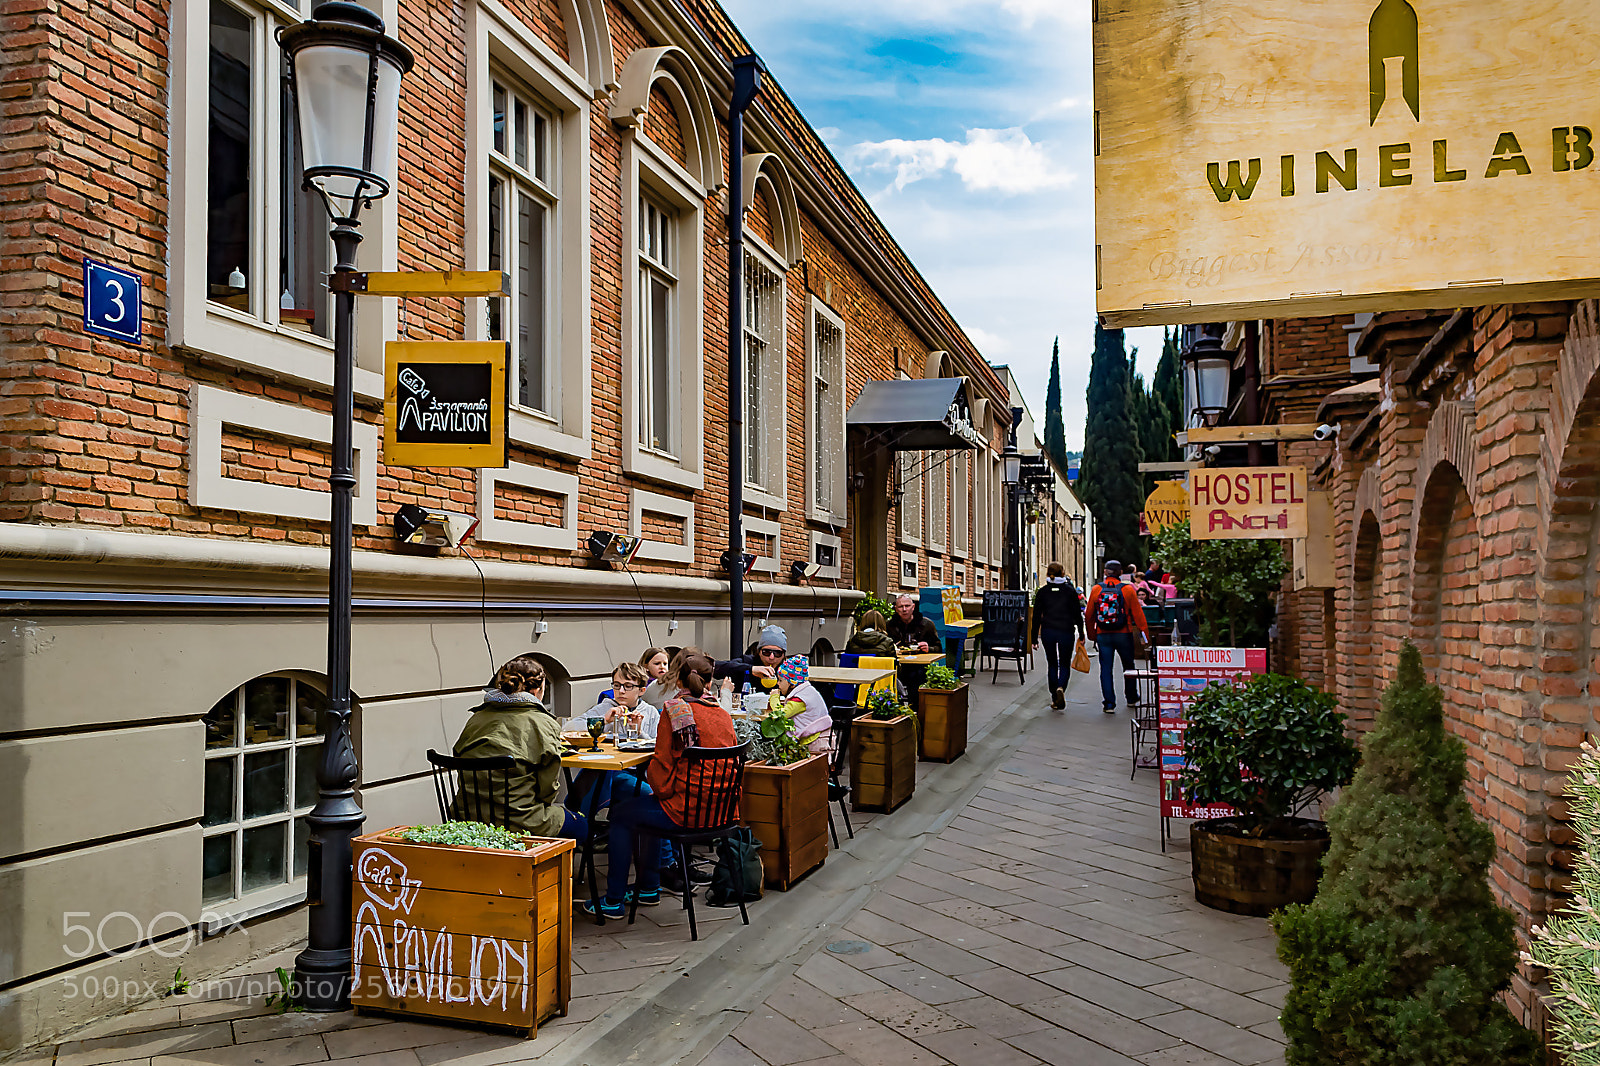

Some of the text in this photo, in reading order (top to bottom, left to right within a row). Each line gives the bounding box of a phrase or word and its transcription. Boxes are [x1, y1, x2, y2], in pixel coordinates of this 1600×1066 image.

[1206, 125, 1595, 203] WINELAB
[104, 279, 126, 323] 3
[403, 372, 419, 390] Cafe
[422, 411, 487, 432] PAVILION
[1194, 473, 1304, 505] HOSTEL
[1158, 650, 1232, 663] OLD WALL TOURS
[363, 855, 394, 893] Cafe
[394, 919, 528, 1013] PAVILION
